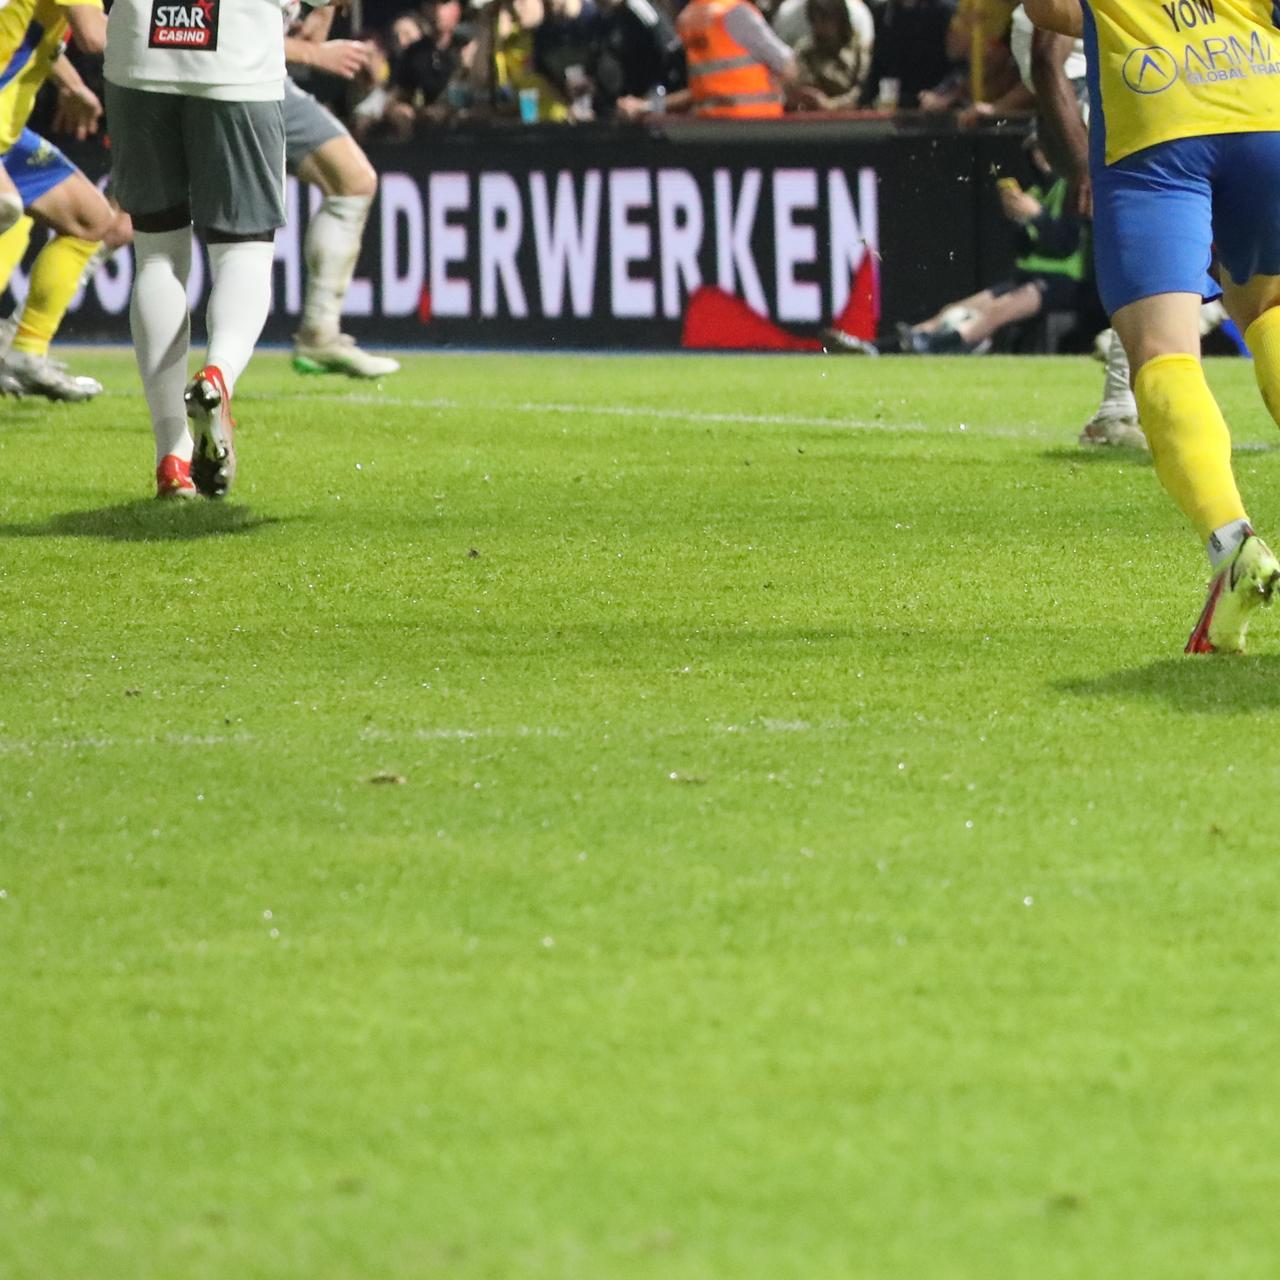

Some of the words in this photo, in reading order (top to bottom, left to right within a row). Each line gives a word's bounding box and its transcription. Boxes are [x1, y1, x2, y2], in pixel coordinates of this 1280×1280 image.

[154, 5, 205, 29] STAR
[158, 29, 205, 44] CASINO
[1186, 67, 1247, 85] GLOBAL
